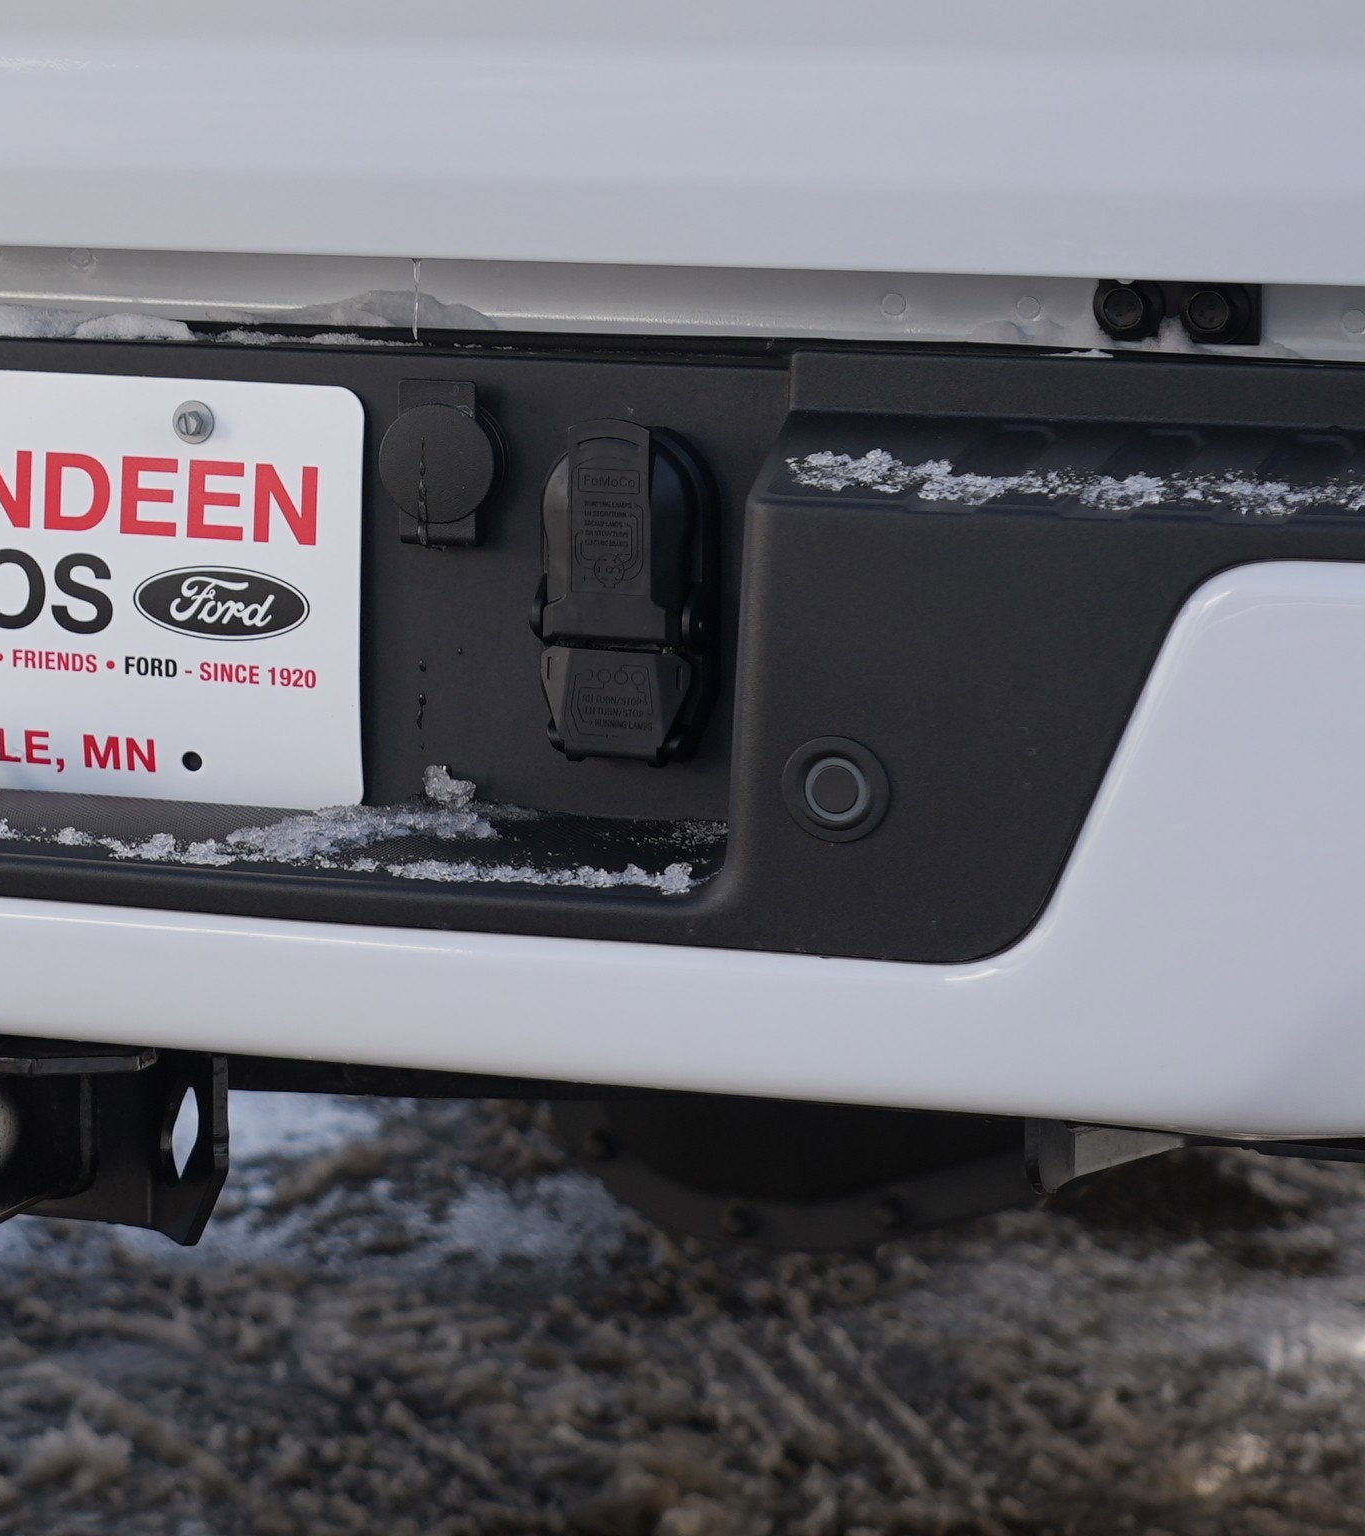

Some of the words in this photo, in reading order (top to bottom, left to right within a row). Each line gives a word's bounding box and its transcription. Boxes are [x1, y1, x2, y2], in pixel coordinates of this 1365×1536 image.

[583, 474, 636, 488] FoMoCo
[169, 575, 275, 627] Ford
[12, 649, 98, 673] FRIENDS
[124, 656, 178, 678] FORD
[199, 662, 260, 685] SINCE
[268, 667, 317, 689] 1920
[83, 734, 157, 773] MN
